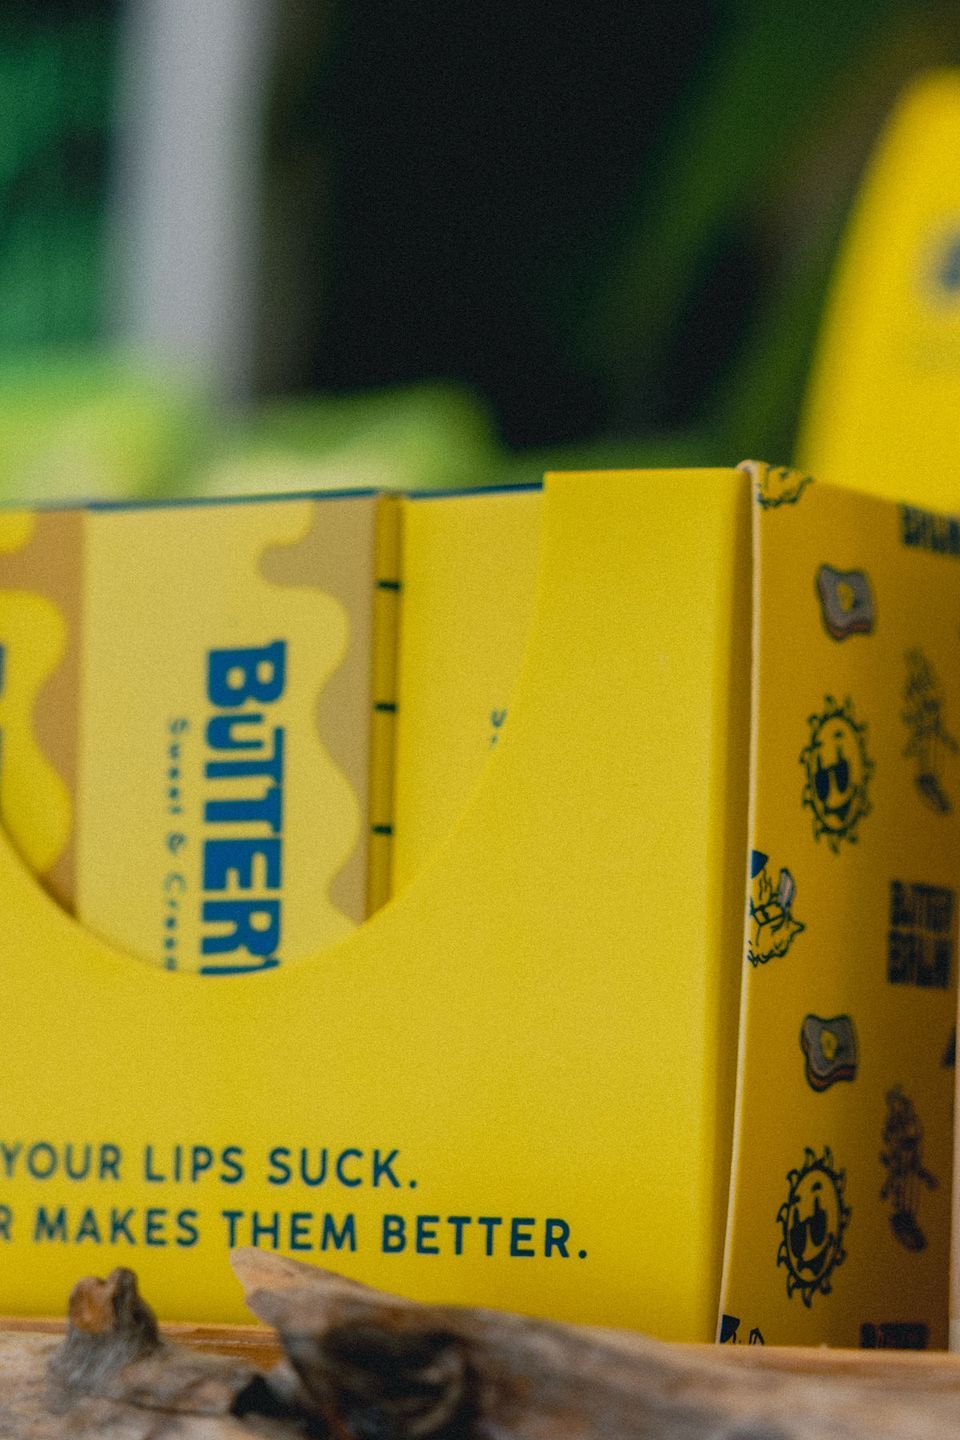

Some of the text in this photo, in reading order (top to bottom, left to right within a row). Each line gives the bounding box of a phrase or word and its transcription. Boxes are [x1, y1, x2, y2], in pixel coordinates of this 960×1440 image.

[0, 1142, 418, 1189] YOUR LIPS SUCK.
[33, 1206, 199, 1248] MAKES
[222, 1210, 357, 1253] THEM
[382, 1214, 588, 1259] BETTER.
